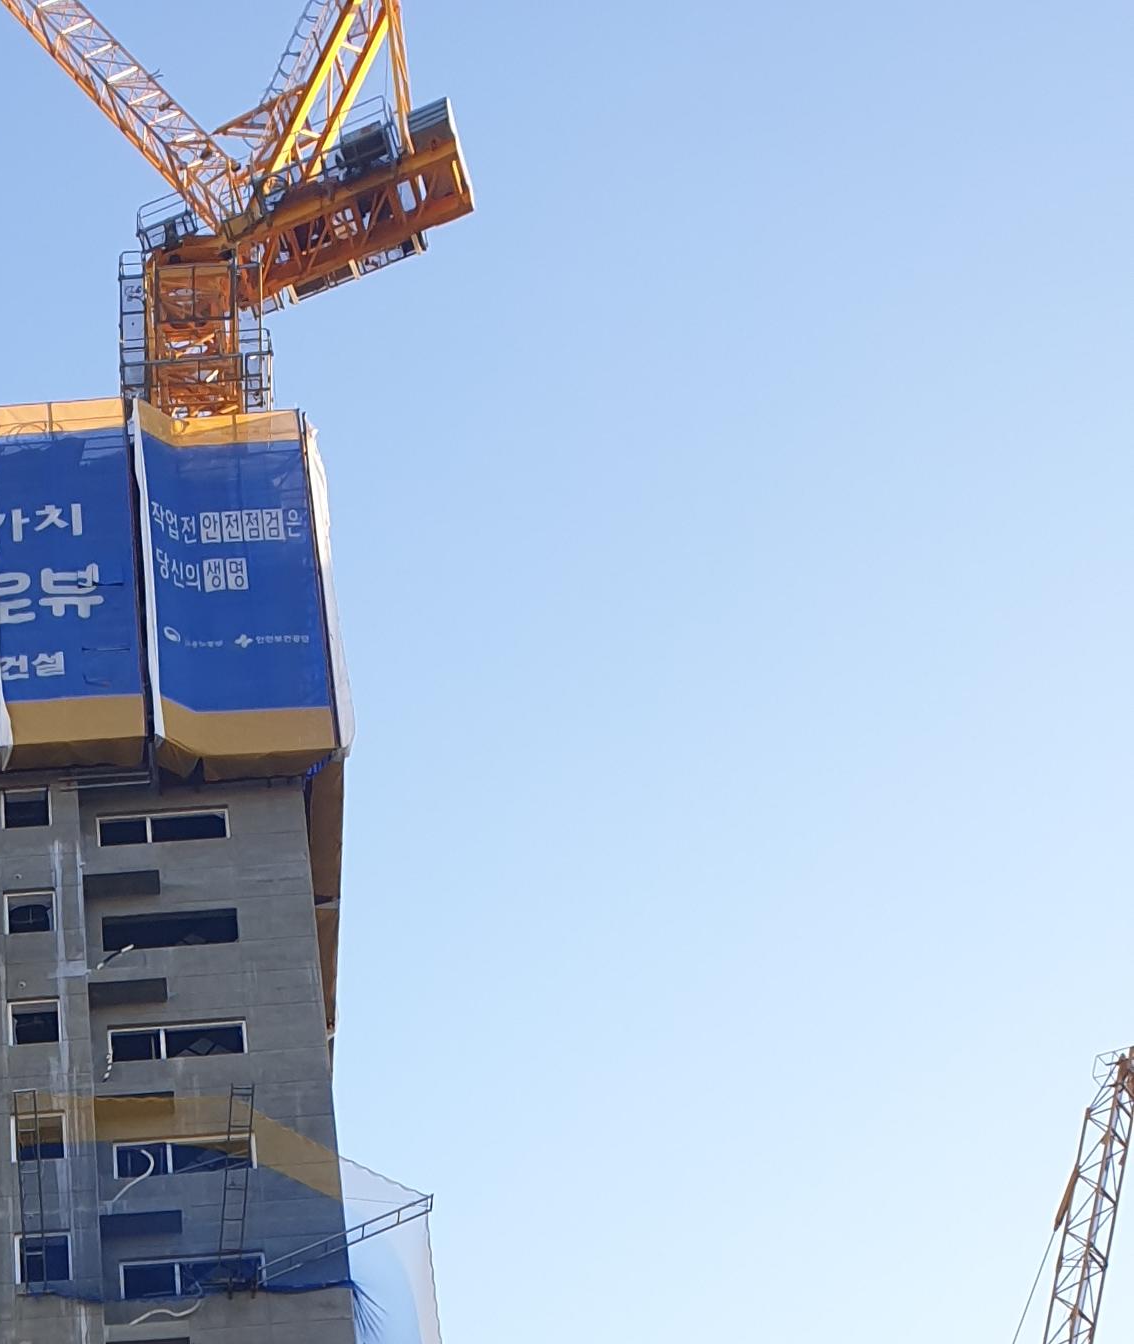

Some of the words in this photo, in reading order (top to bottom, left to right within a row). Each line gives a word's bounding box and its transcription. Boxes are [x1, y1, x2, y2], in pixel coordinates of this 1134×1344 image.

[151, 501, 197, 544] 작업전
[201, 508, 302, 544] 안전점검은
[156, 548, 201, 592] 당신의
[205, 559, 247, 591] 생명
